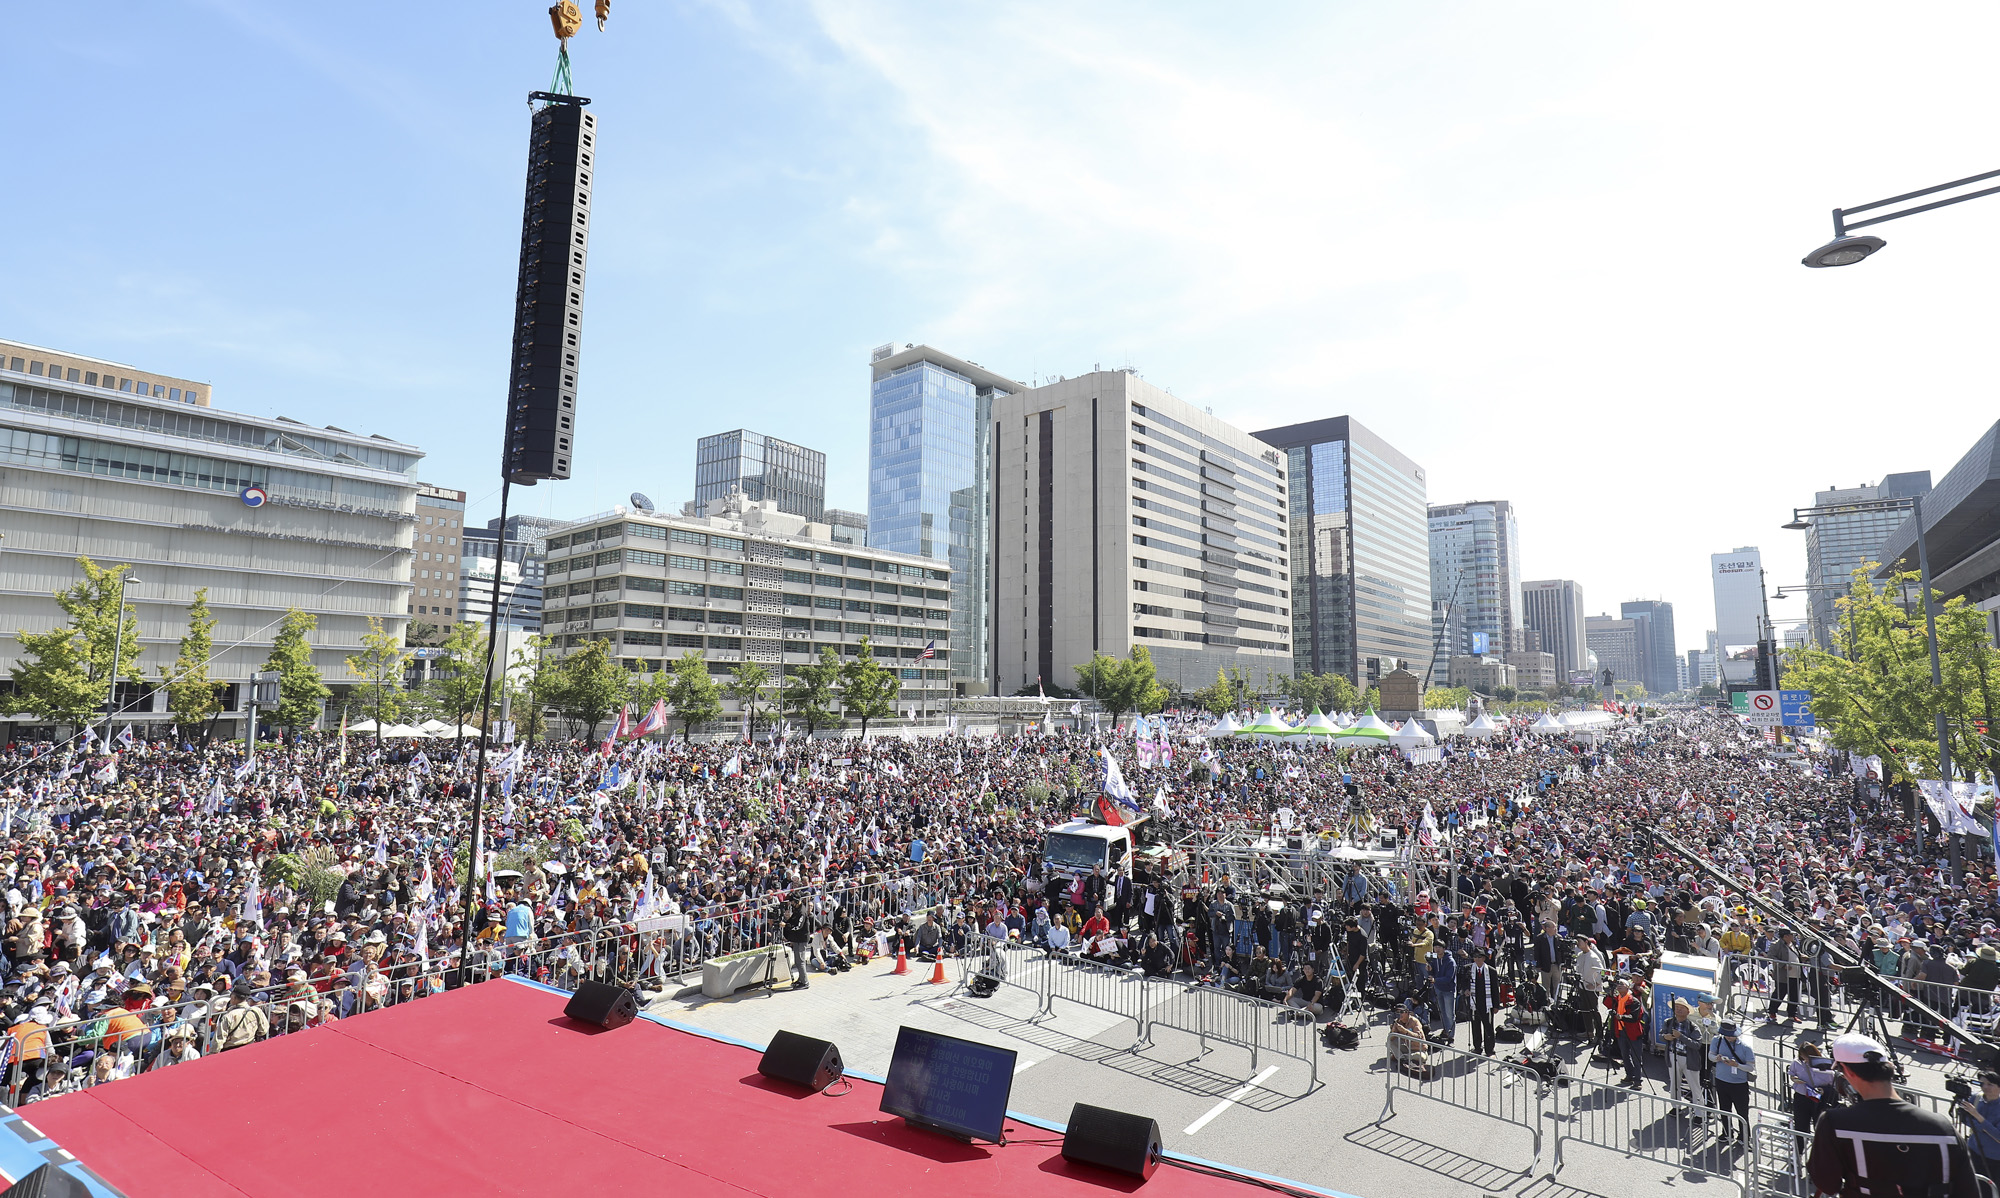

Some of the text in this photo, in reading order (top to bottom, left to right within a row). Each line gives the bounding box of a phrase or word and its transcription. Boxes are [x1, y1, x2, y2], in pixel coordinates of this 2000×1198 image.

[417, 486, 459, 501] ELIM
[271, 493, 418, 523] 대한민국역사박물관
[183, 523, 226, 533] NATIONAL
[229, 528, 269, 538] MUSEUM
[270, 532, 283, 540] OF
[284, 534, 317, 543] KOREAN
[1718, 561, 1755, 570] 조선일보
